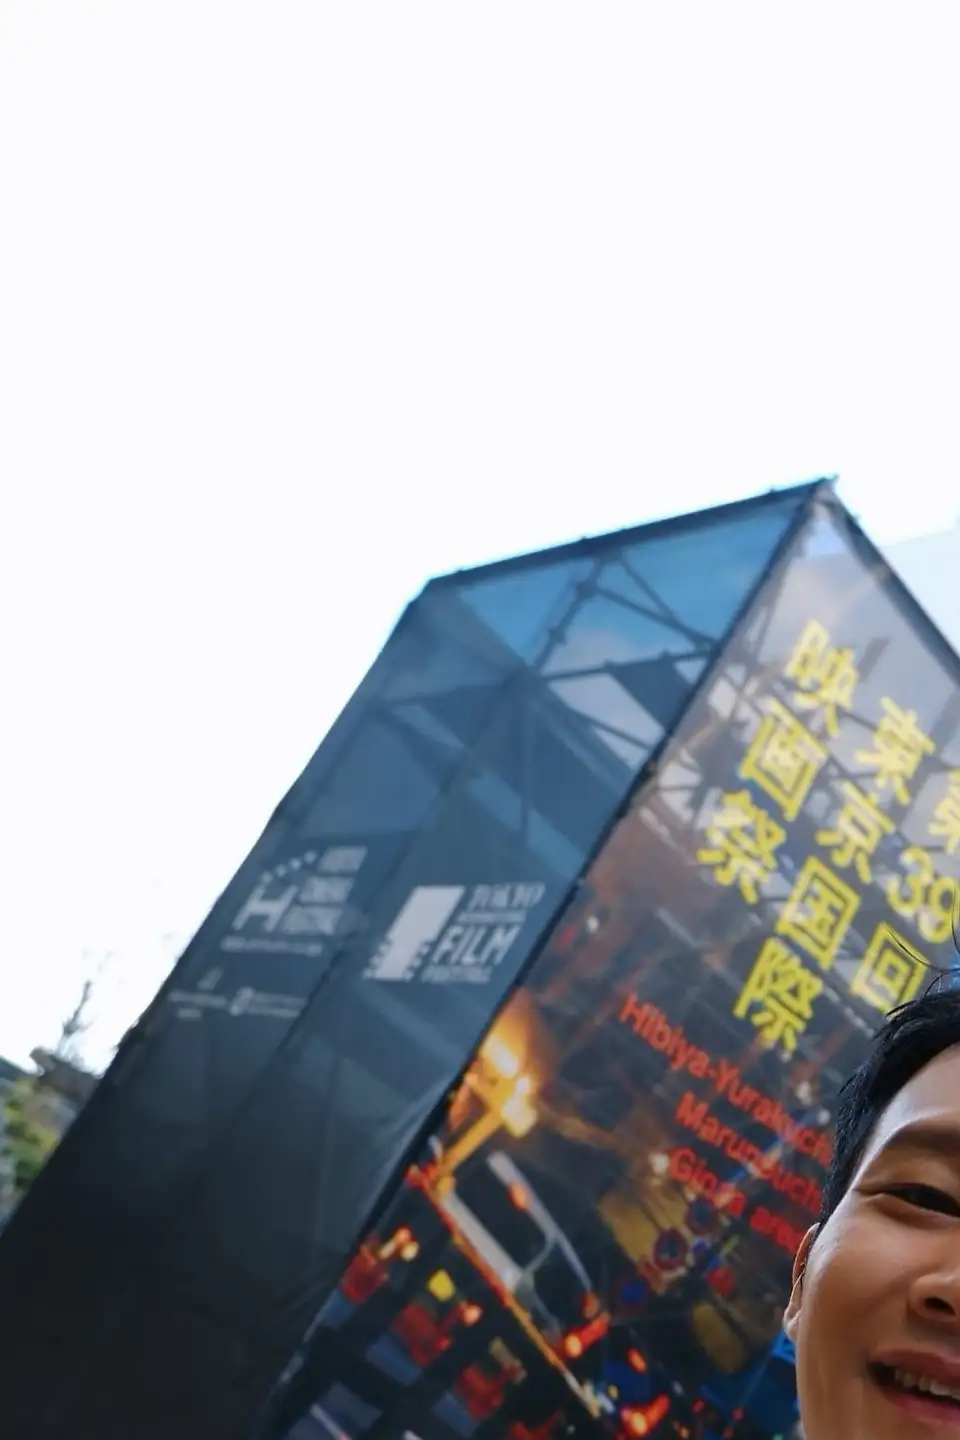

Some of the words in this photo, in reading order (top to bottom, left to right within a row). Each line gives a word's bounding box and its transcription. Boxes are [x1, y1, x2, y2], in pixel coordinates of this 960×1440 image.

[695, 618, 859, 904] 映画祭
[731, 697, 937, 1054] 東京国際
[431, 924, 521, 966] FILM
